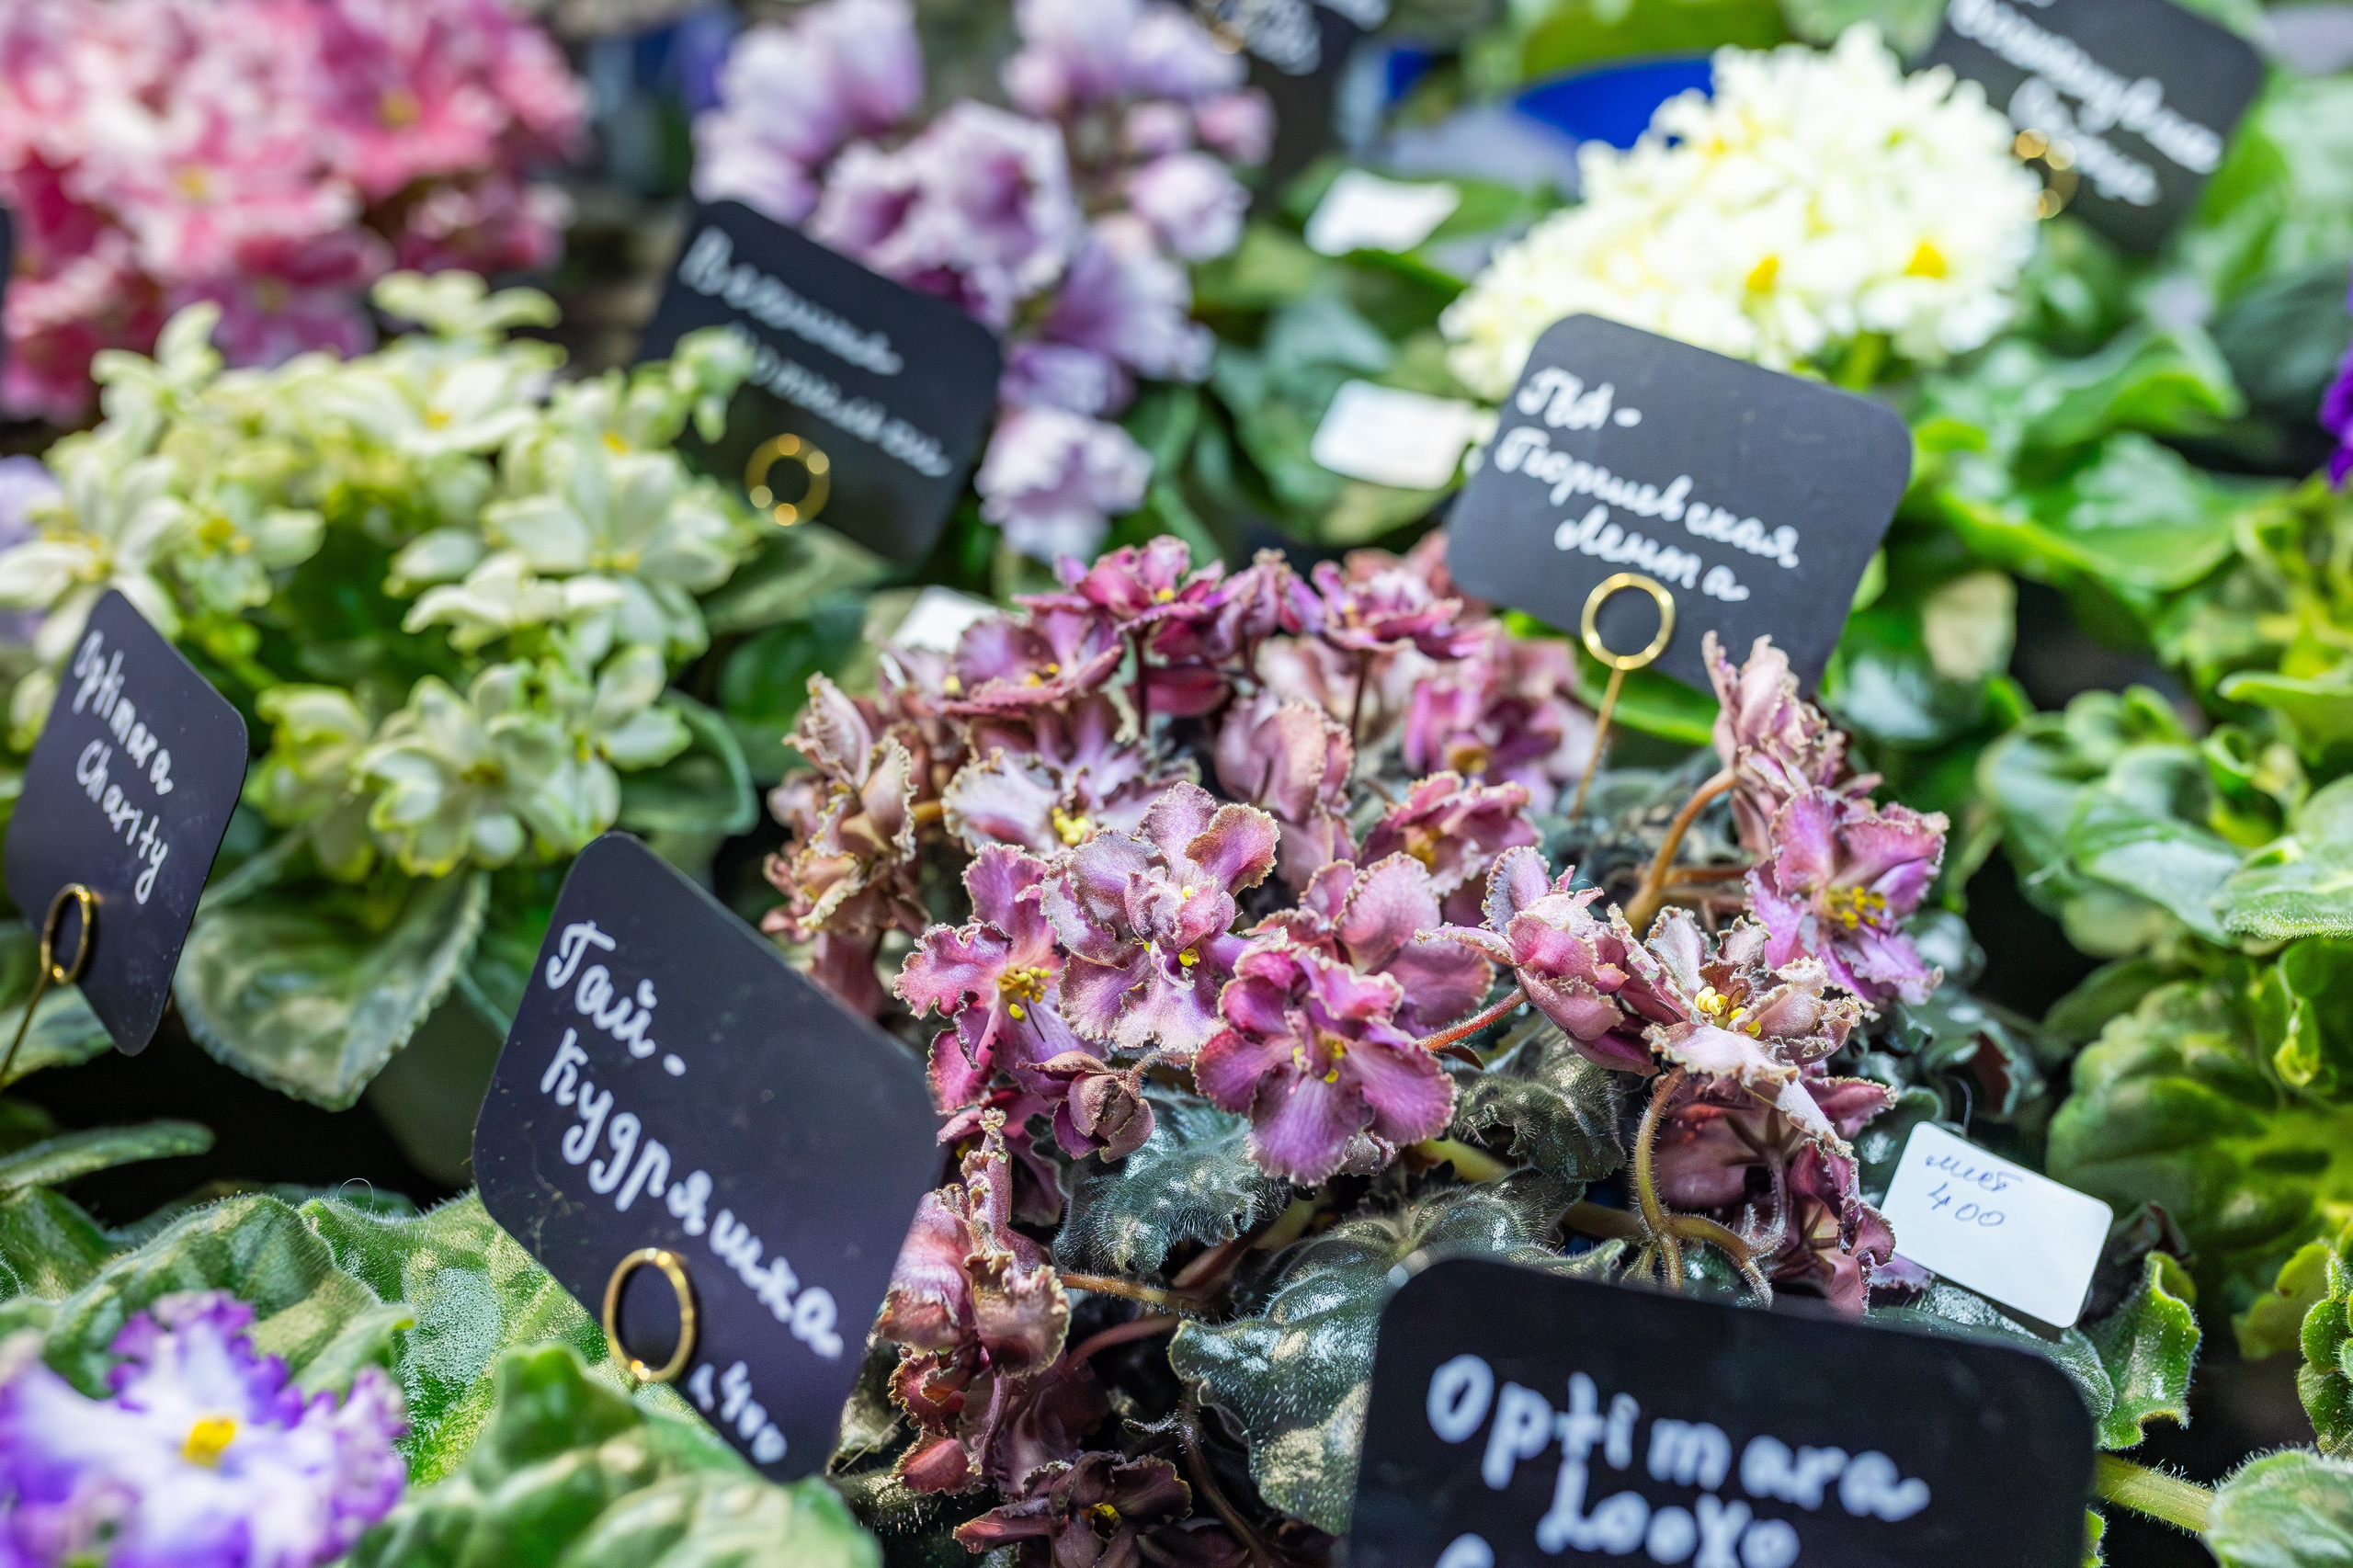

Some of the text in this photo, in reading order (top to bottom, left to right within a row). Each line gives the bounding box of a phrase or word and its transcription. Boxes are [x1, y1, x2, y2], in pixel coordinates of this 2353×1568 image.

[73, 630, 174, 795] Optimara
[76, 739, 168, 905] Charity
[1927, 1182, 2006, 1227] 400
[1427, 1355, 1929, 1522] Optimara
